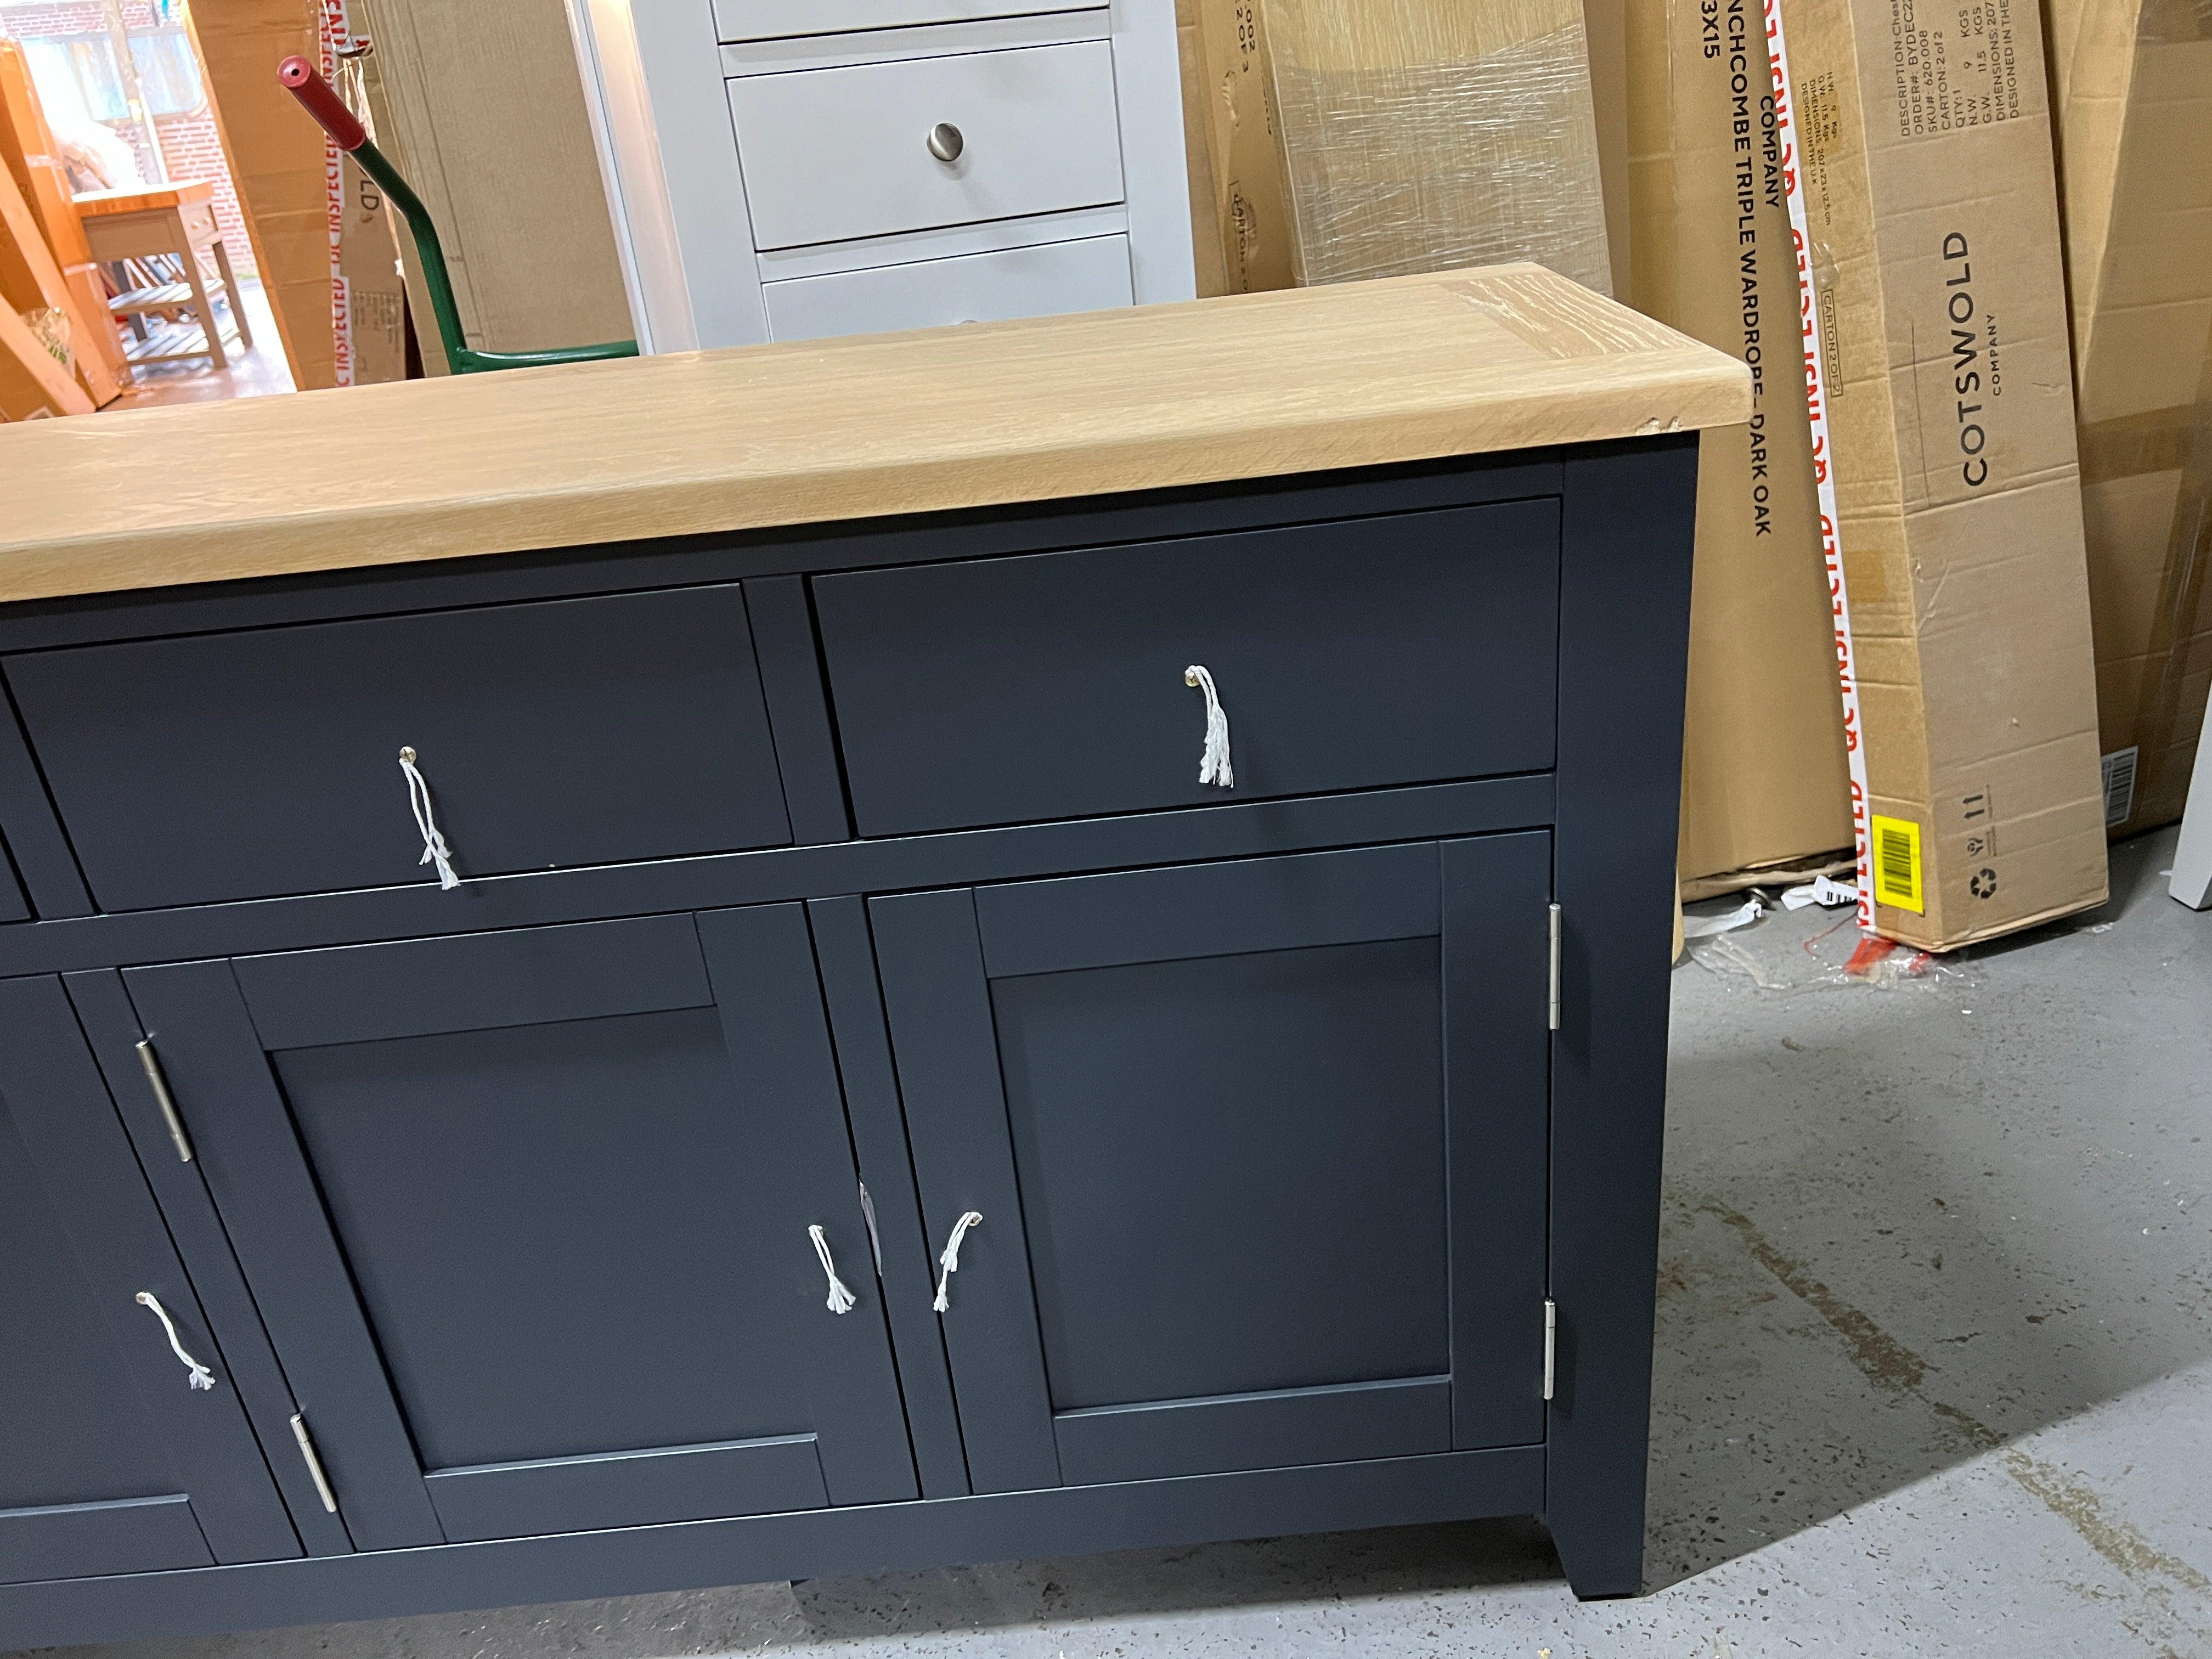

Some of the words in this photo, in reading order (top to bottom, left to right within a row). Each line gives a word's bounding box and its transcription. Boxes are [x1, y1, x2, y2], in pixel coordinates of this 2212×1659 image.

[1236, 7, 1243, 21] 2
[1239, 25, 1248, 55] OF
[1244, 0, 1256, 53] .002
[1959, 9, 1970, 38] KGS
[1973, 7, 1983, 35] KGS
[1999, 0, 2010, 26] THE
[2002, 29, 2013, 44] IN
[1918, 30, 1933, 86] 620.008
[1977, 50, 1987, 73] 11.5
[1989, 28, 2006, 122] DIMENSIONS:
[2004, 47, 2019, 119] DESIGNED
[1760, 95, 1779, 207] COMPANY
[1801, 83, 1812, 136] DESIGNED
[1808, 148, 1816, 168] THE
[1736, 156, 1756, 245] TRIPLE
[1823, 295, 1835, 352] CARTON
[1830, 364, 1839, 383] OF
[1943, 232, 1988, 487] COTSWOLD
[1987, 314, 2002, 396] COMPANY
[1749, 414, 1768, 481] DARK
[1753, 485, 1771, 537] OAK
